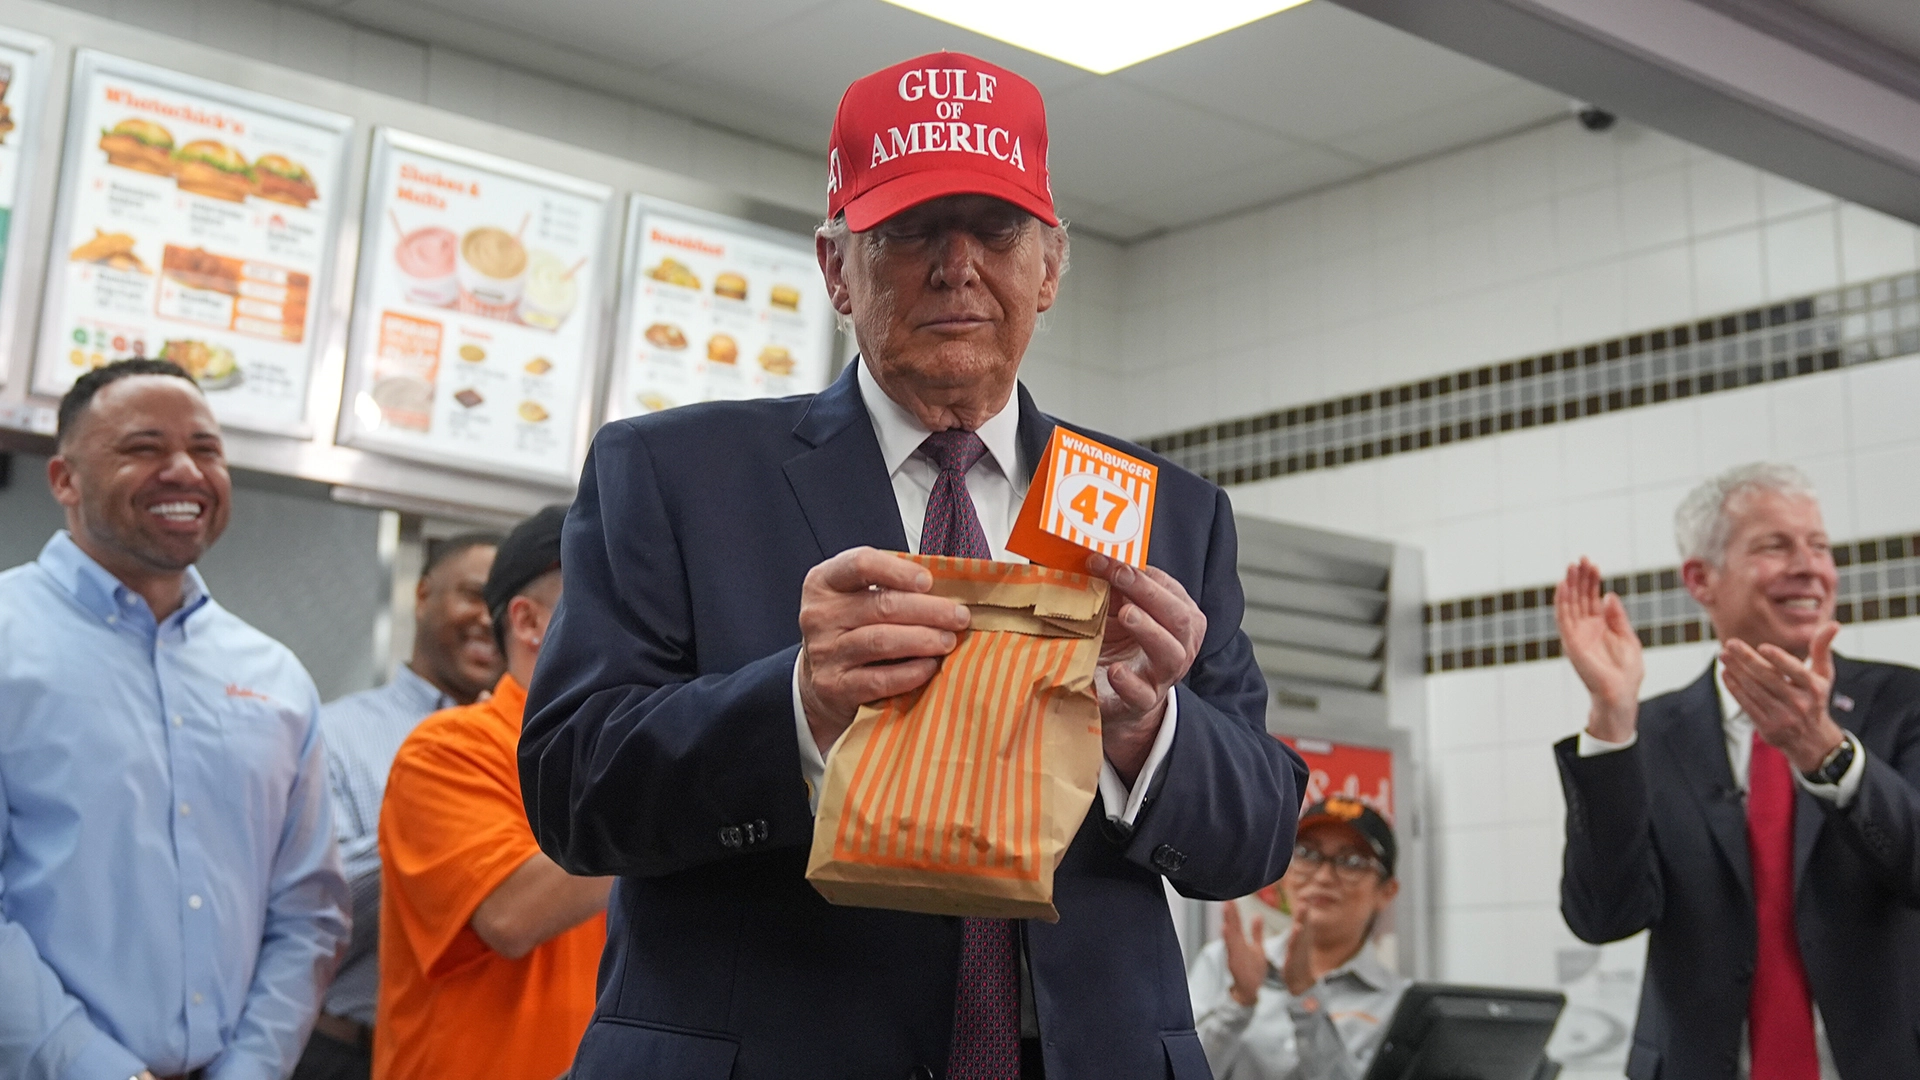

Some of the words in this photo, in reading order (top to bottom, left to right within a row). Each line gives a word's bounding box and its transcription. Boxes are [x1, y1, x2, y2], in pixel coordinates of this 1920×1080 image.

[898, 68, 997, 104] GULF
[936, 101, 964, 120] OF
[869, 121, 1026, 172] AMERICA
[401, 164, 465, 192] Shakes
[651, 229, 725, 257] Breakfast
[1061, 434, 1152, 481] WHATABURGER
[1070, 484, 1129, 534] 47
